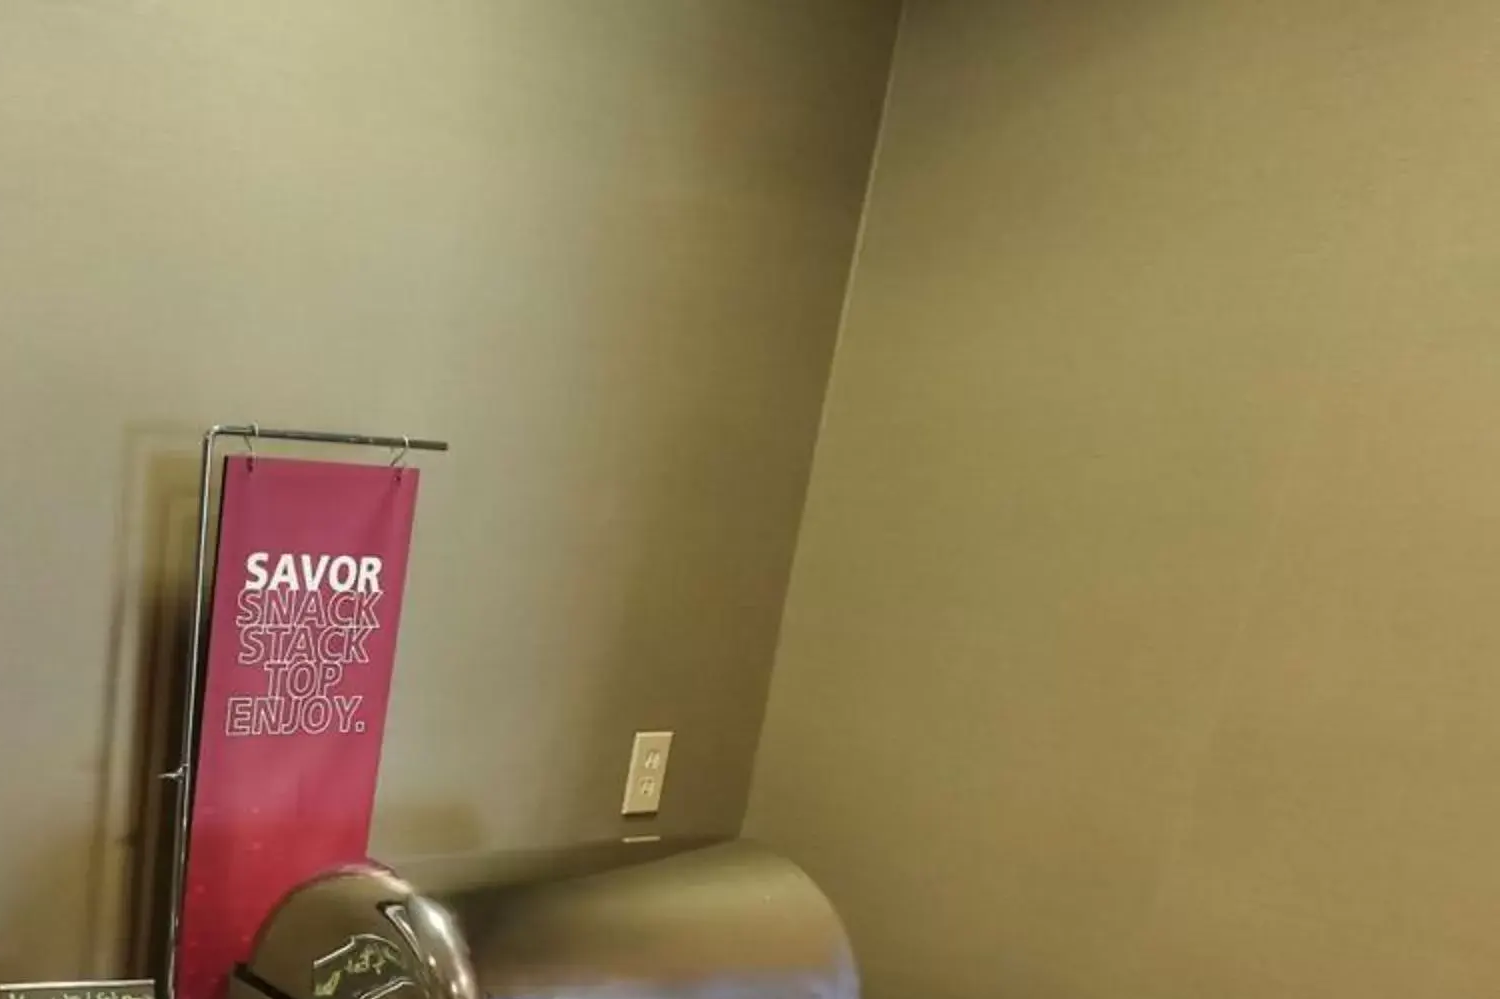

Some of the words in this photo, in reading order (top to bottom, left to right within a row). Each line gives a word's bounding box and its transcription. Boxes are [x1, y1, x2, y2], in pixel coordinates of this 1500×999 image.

[245, 551, 382, 593] SAVOR
[236, 589, 381, 629] SNACK
[238, 625, 370, 664] STACK
[263, 659, 342, 699] TOP
[226, 695, 365, 736] ENJOY.
